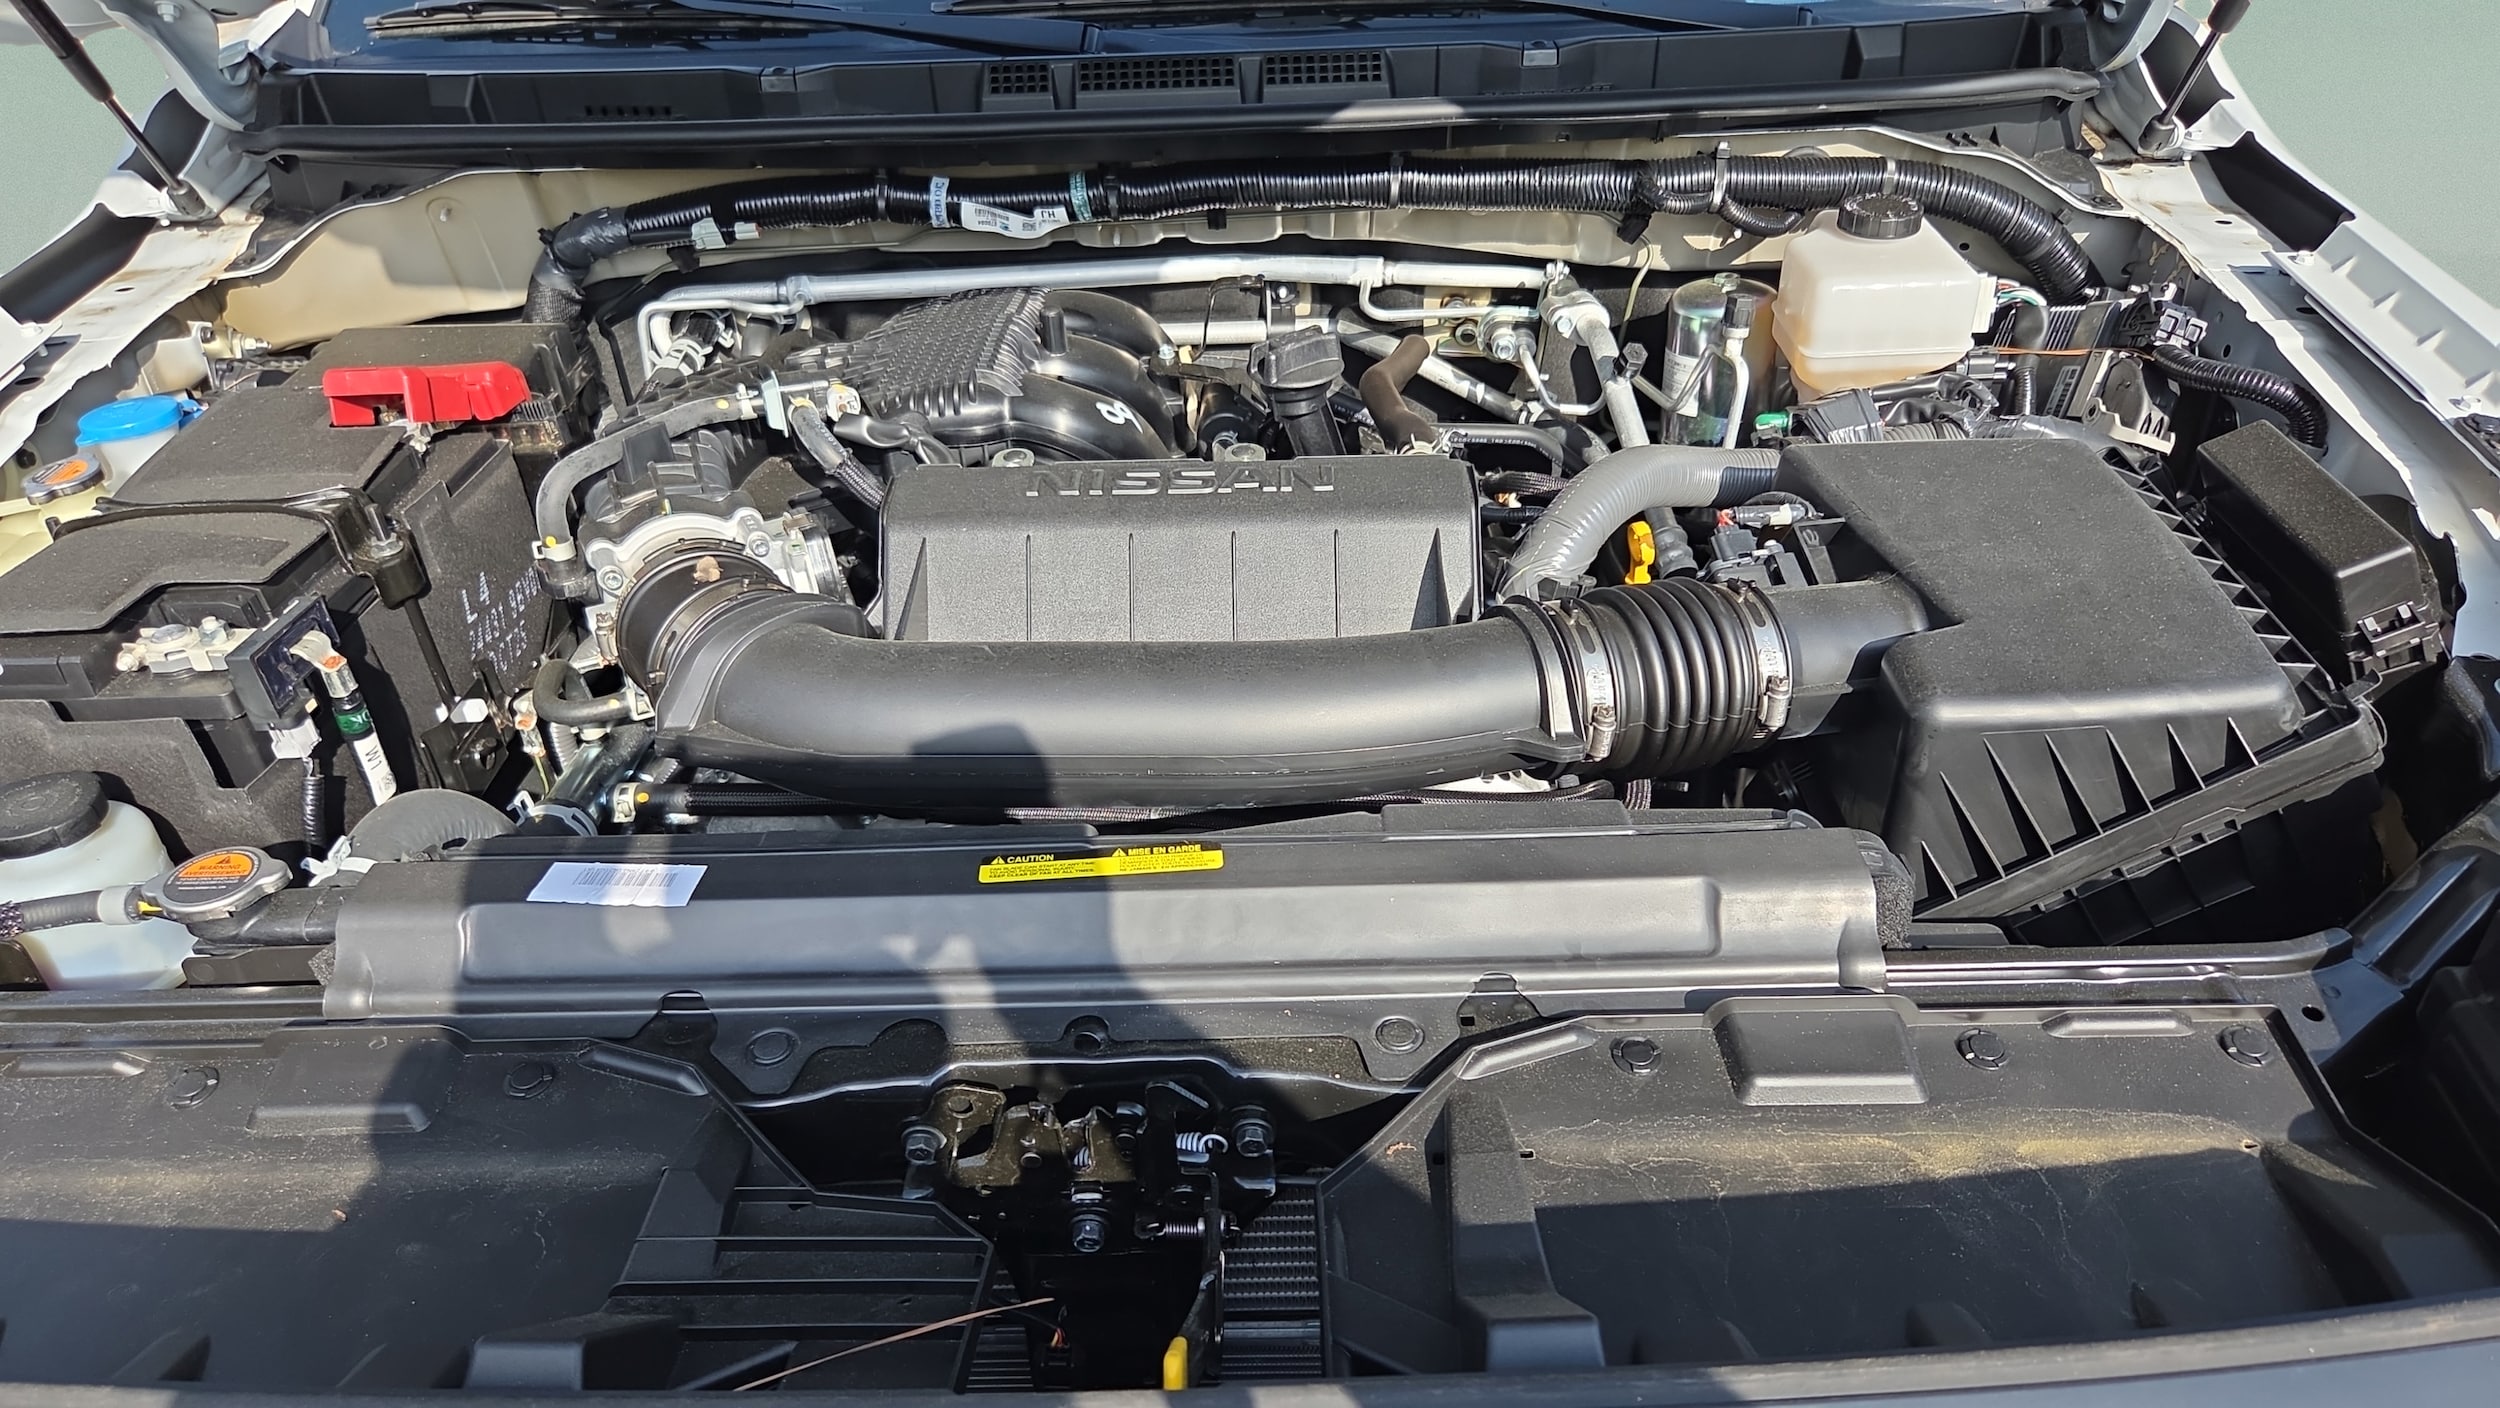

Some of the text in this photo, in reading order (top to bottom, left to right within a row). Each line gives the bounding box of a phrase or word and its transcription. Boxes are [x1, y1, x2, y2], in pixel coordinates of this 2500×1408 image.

[1025, 464, 1335, 496] NISSAN
[1127, 844, 1201, 856] MISE EN GARDE
[1006, 854, 1054, 863] CAUTION
